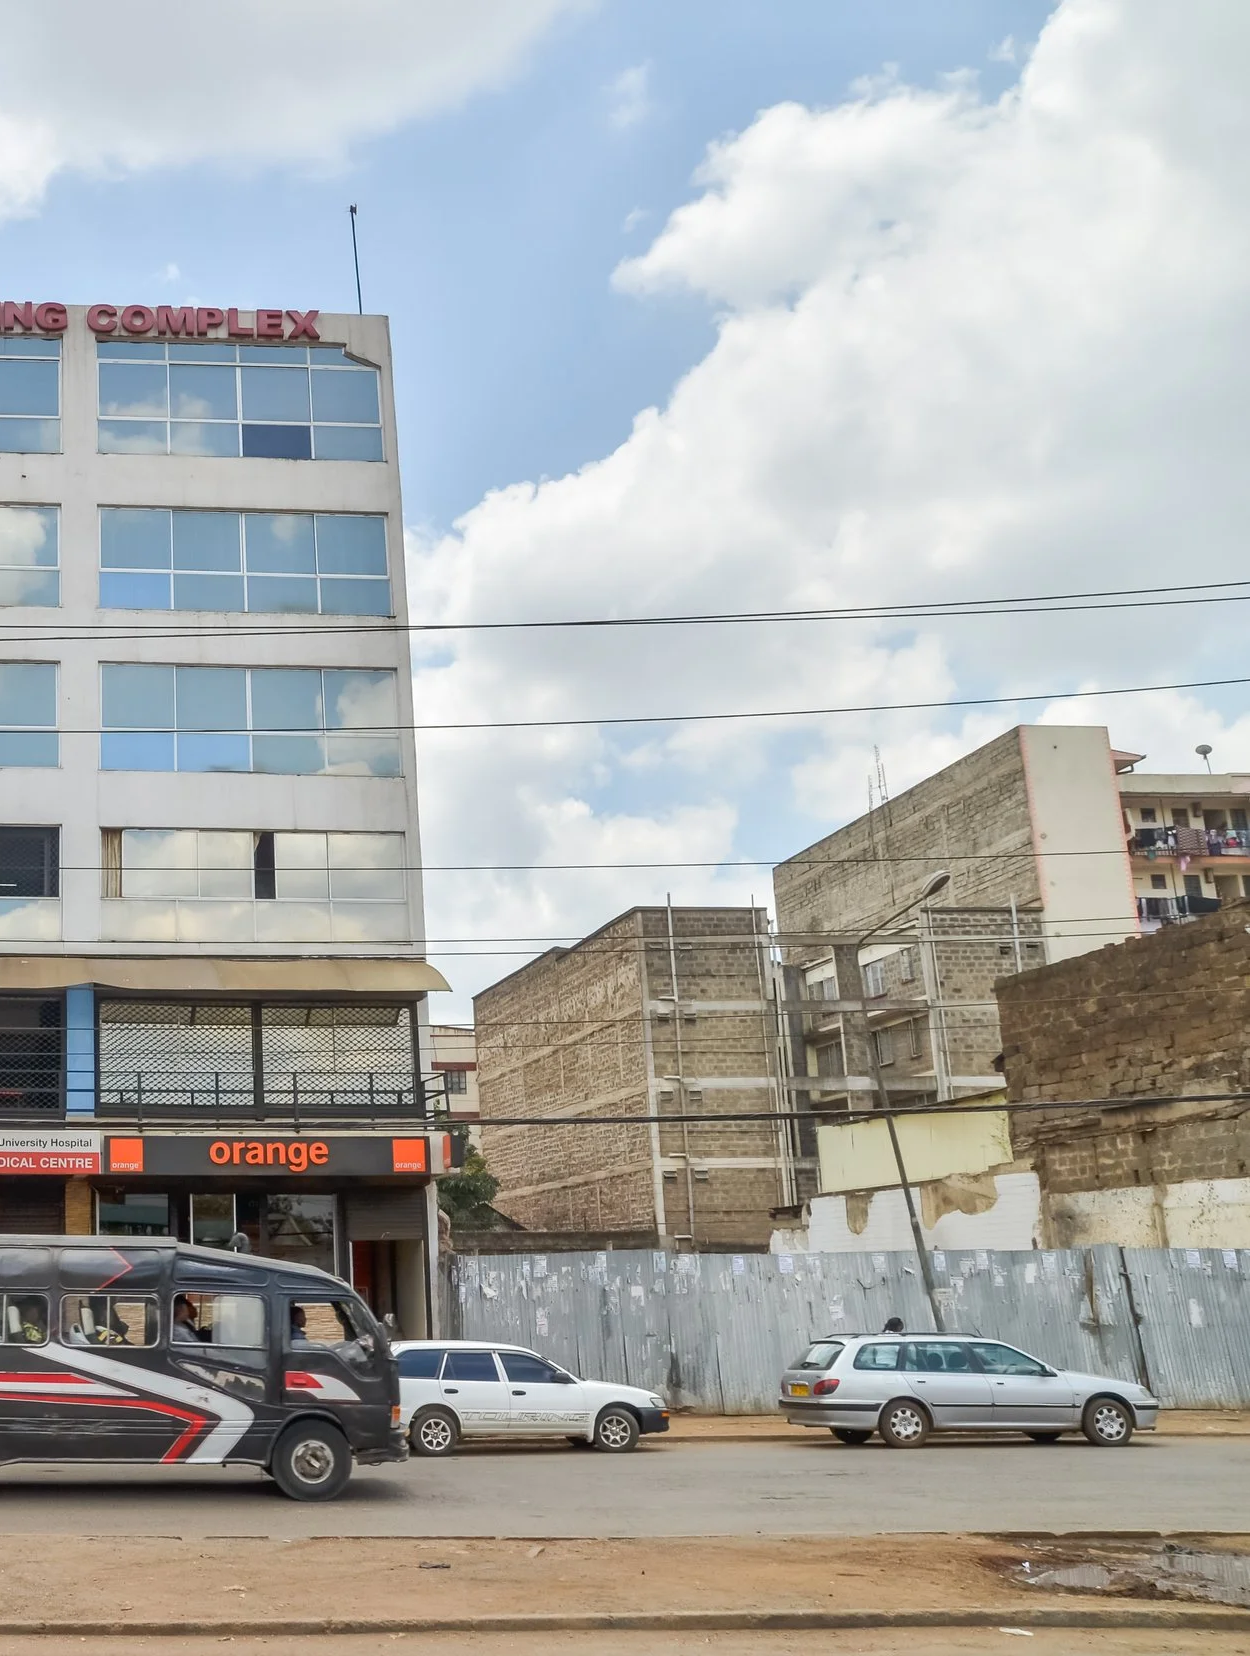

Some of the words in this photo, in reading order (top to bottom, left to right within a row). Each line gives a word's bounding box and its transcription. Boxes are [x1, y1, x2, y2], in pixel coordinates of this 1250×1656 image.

[87, 303, 320, 340] COMPLEX
[50, 1138, 92, 1149] Hospital
[209, 1140, 329, 1172] orange
[40, 1157, 93, 1169] CENTRE
[112, 1162, 139, 1171] orange
[395, 1162, 422, 1171] orange
[460, 1411, 591, 1422] TOURING
